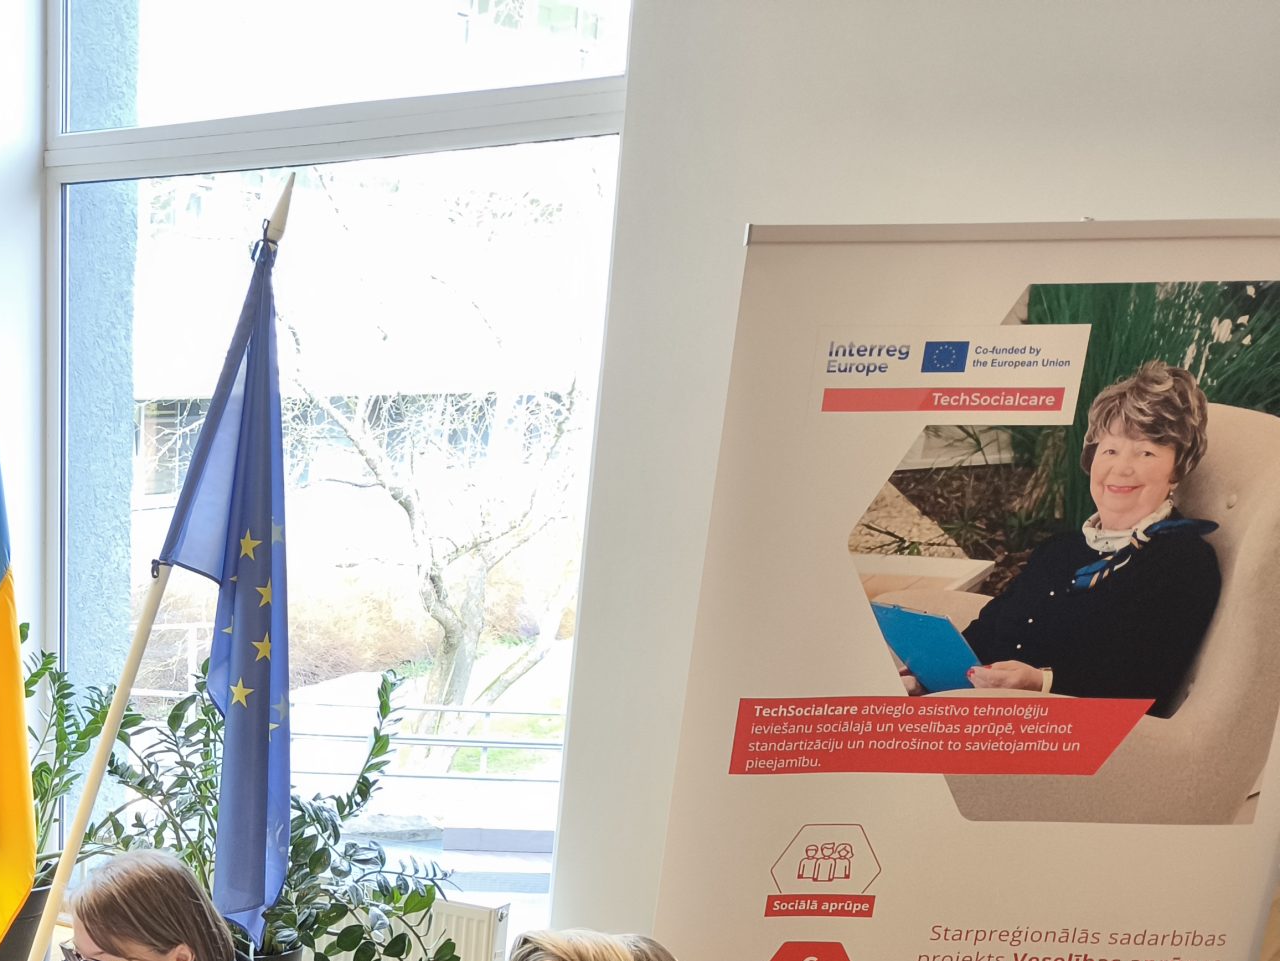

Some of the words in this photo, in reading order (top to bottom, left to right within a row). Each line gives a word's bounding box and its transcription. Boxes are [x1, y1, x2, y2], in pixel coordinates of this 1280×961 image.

[828, 341, 910, 360] Interreg
[974, 345, 1026, 355] Co-funded
[1029, 345, 1042, 356] by
[826, 359, 889, 376] Europe
[972, 358, 988, 368] the
[990, 358, 1039, 369] European
[1041, 358, 1071, 368] Union
[931, 391, 1056, 407] TechSocialcare
[754, 703, 858, 717] TechSocialcare
[861, 703, 915, 718] atvieglo
[917, 704, 969, 716] asistīvo
[973, 703, 1049, 720] tehnoloģiju
[750, 722, 813, 735] ieviešanu
[816, 720, 872, 736] sociālajā
[876, 722, 895, 733] un
[898, 720, 961, 734] veselības
[963, 722, 1016, 737] aprūpē,
[1020, 722, 1073, 734] veicinot
[748, 739, 843, 753] standartizāciju
[847, 739, 865, 750] un
[868, 738, 944, 751] nodrošinot
[947, 739, 962, 751] to
[964, 739, 1059, 754] savietojamību
[1062, 741, 1081, 752] un
[745, 756, 822, 772] pieejamību.
[772, 899, 818, 911] Sociālā
[821, 901, 870, 914] aprūpe
[929, 924, 1101, 947] Starpreģionālās
[1107, 929, 1227, 947] sadarbības
